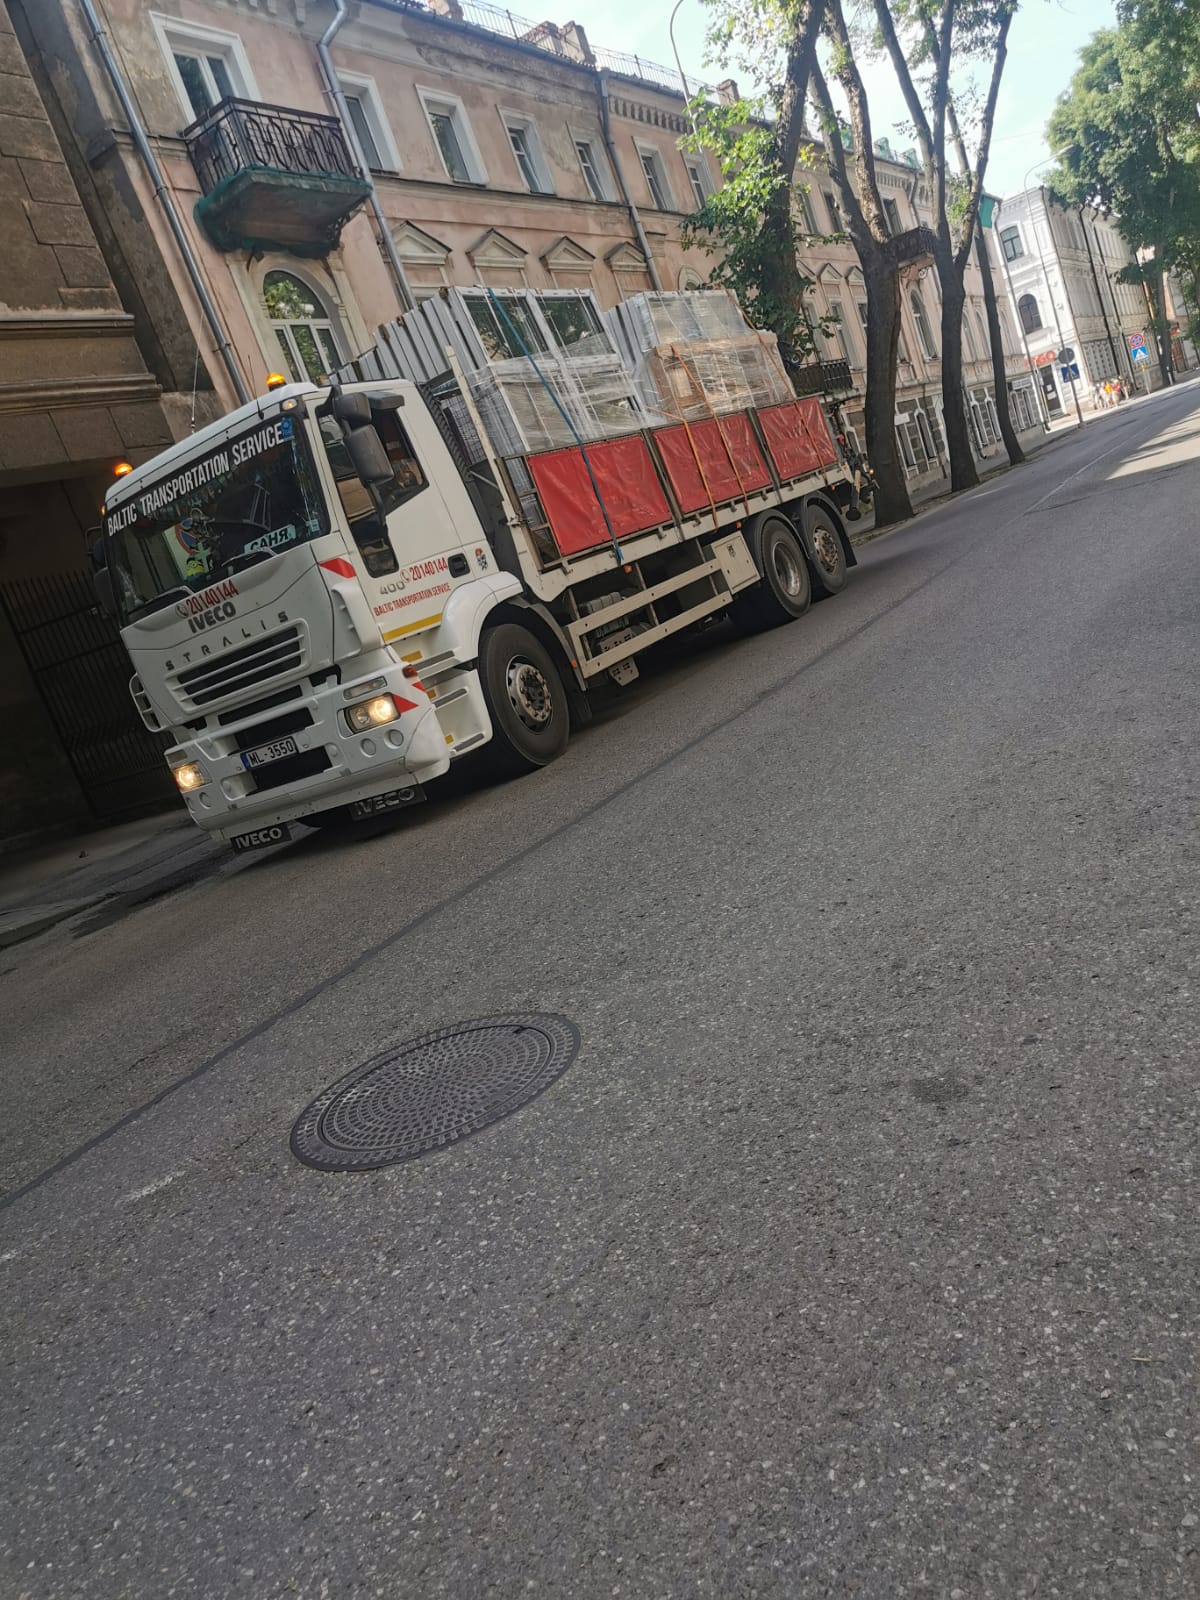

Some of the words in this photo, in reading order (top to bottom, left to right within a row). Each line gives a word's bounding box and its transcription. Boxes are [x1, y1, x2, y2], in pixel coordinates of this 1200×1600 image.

[107, 503, 138, 537] BALTIC
[139, 451, 230, 517] TRANSPORTATION
[231, 422, 285, 466] SERVICE
[409, 557, 448, 581] 20140144
[186, 579, 239, 615] 20140144
[373, 602, 394, 617] BALTIC
[431, 582, 451, 596] SERVICE
[380, 581, 406, 595] 400
[188, 601, 237, 634] IVECO
[165, 611, 288, 671] STRALIS
[355, 788, 415, 816] IVECO
[235, 827, 283, 850] IVECO
